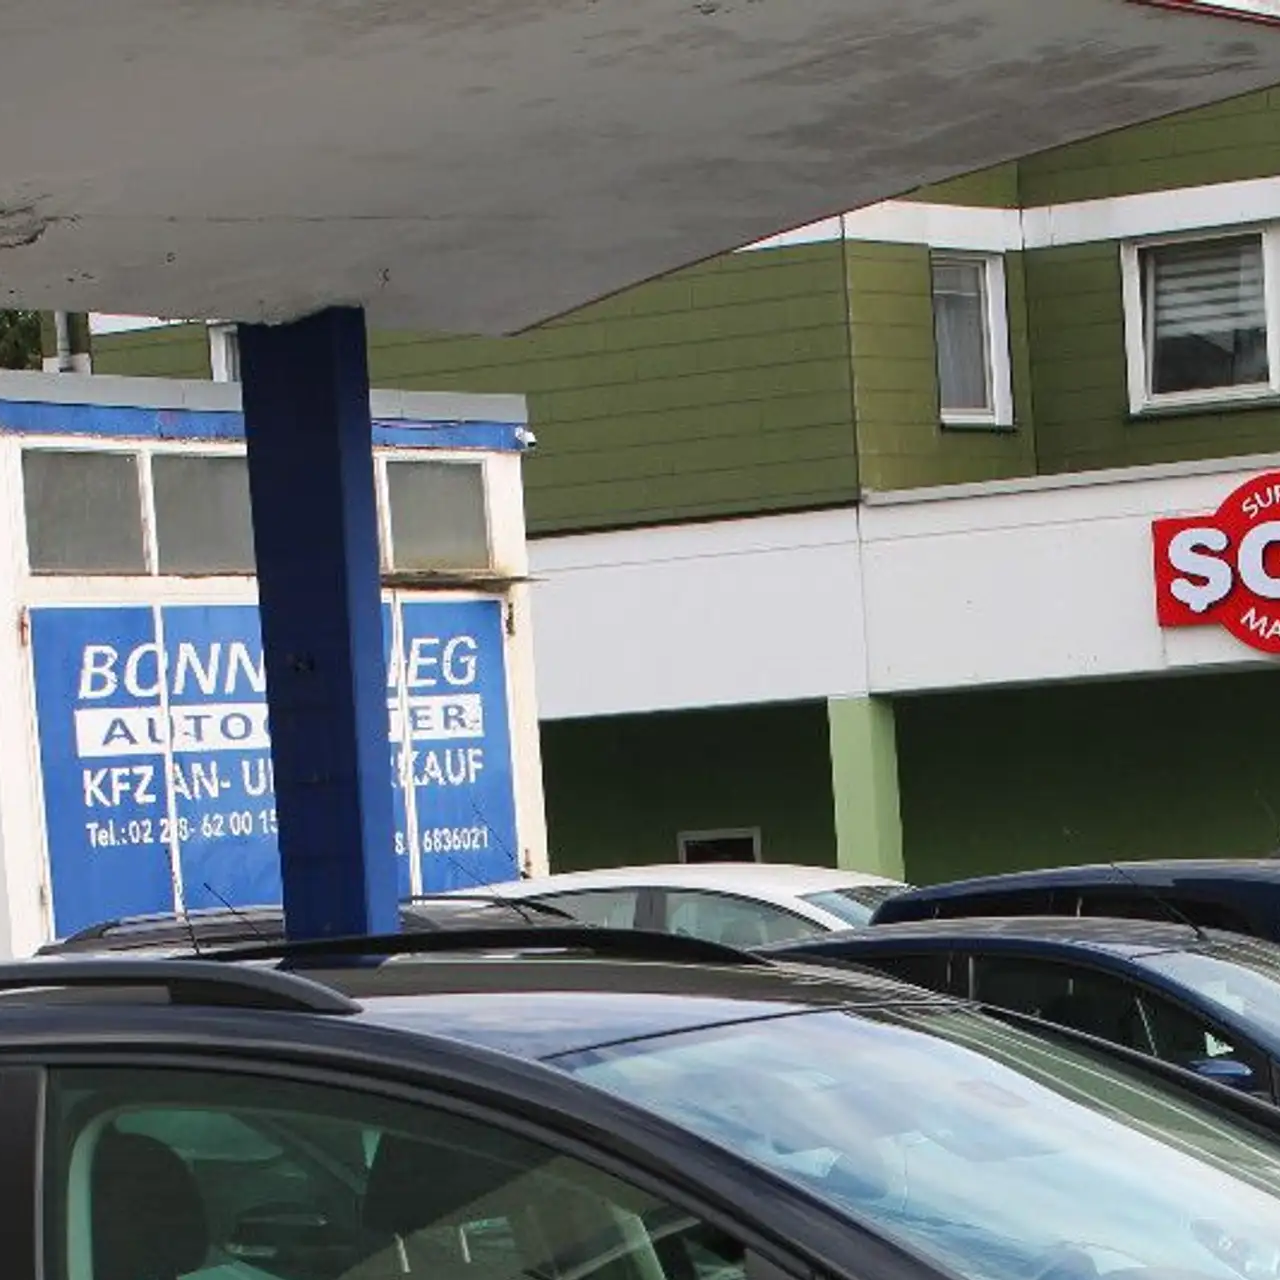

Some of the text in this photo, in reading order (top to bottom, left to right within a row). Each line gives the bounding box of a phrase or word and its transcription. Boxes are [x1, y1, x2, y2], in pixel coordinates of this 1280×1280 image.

[79, 642, 267, 699] BONN
[102, 712, 269, 746] AUTO
[83, 765, 157, 808] KFZ
[391, 748, 484, 788] KAUF
